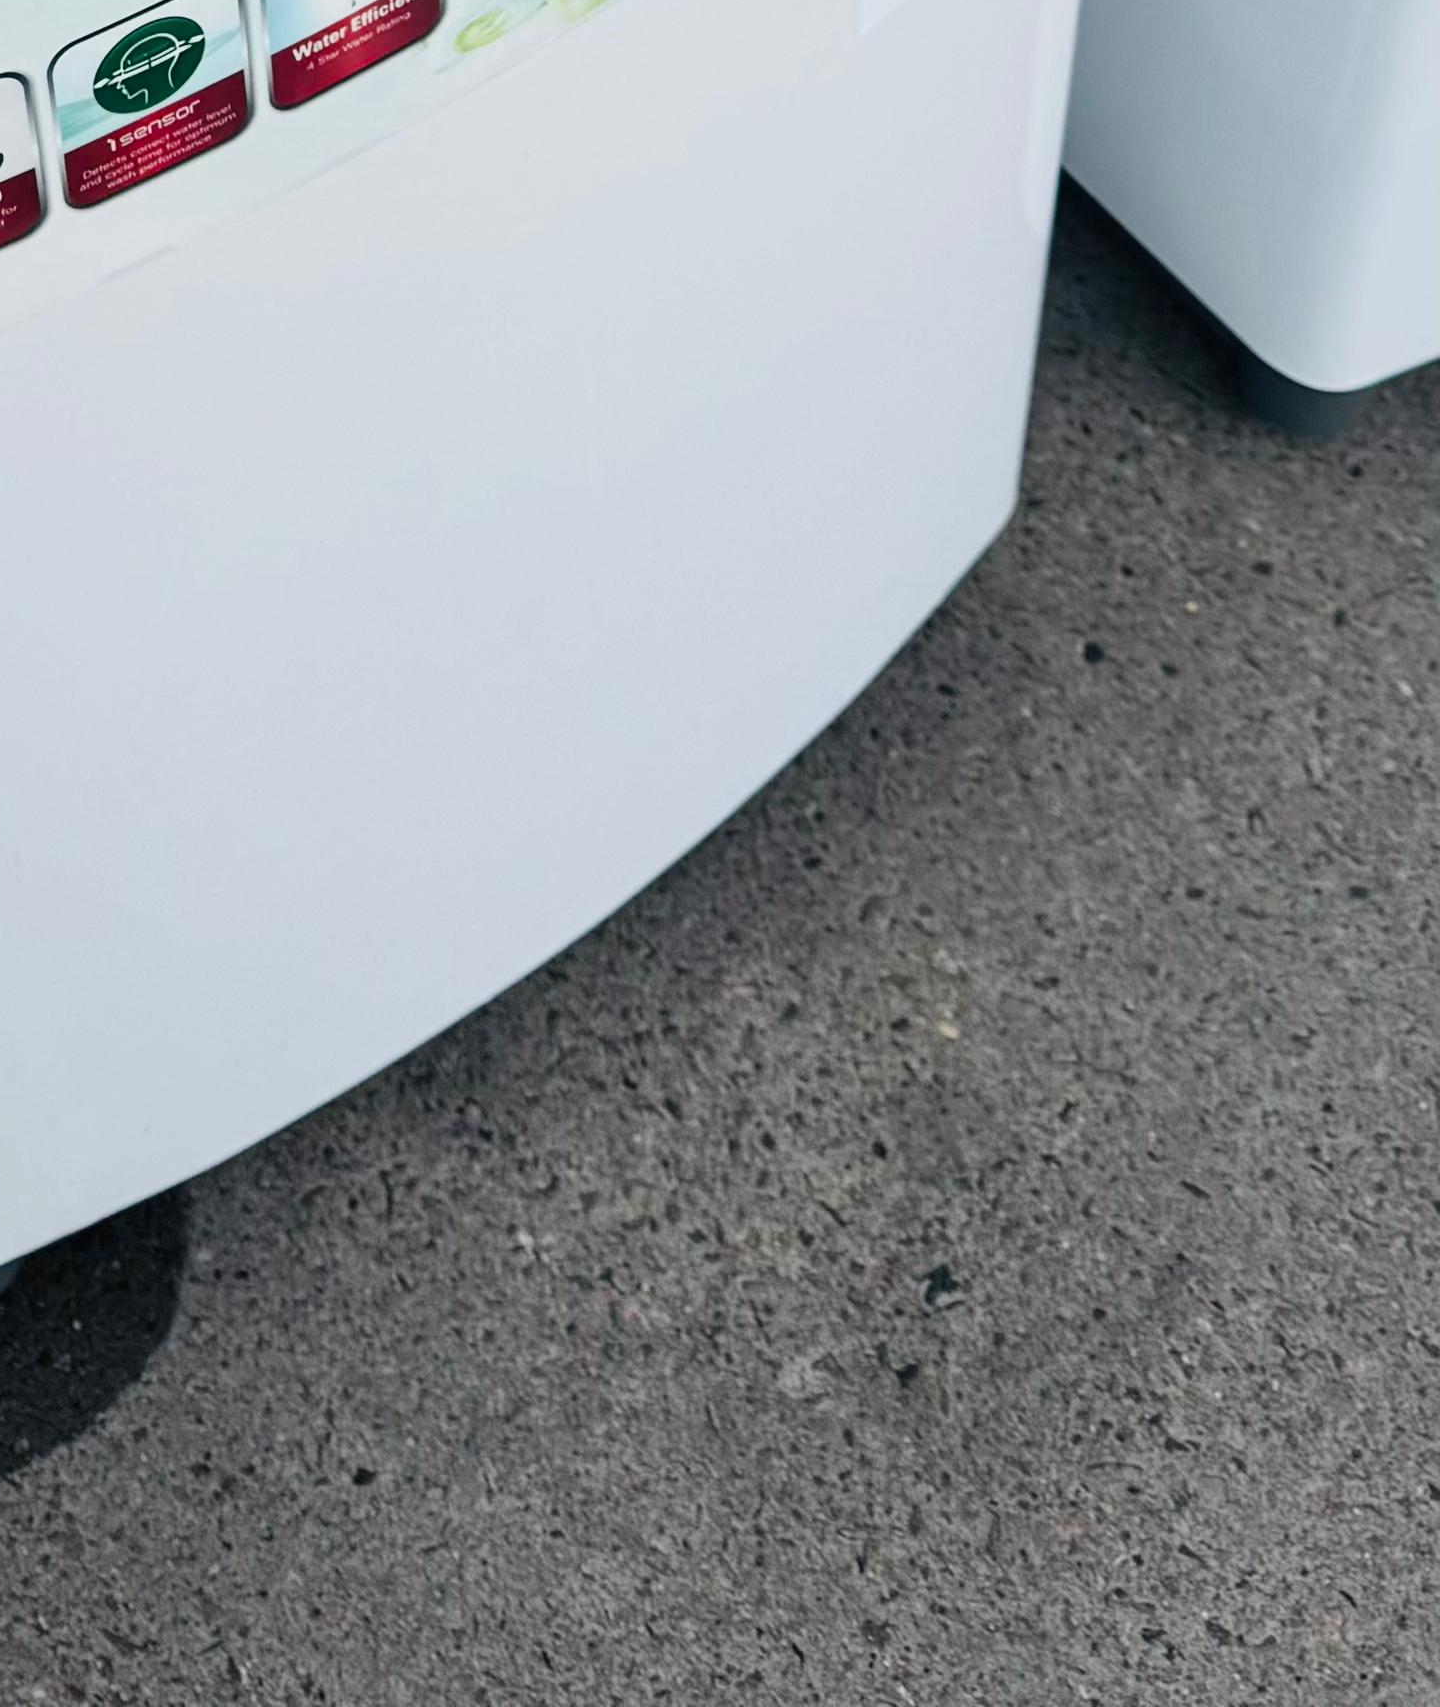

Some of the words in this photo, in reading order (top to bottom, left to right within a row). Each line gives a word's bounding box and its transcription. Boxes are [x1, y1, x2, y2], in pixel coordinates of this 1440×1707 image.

[292, 25, 348, 63] Water
[79, 176, 103, 193] and
[105, 161, 135, 184] cycle
[137, 147, 164, 166] time
[165, 139, 182, 154] for
[184, 111, 238, 144] optimum
[82, 154, 128, 181] Detects
[130, 133, 171, 159] correct
[172, 118, 203, 138] water
[206, 103, 233, 122] level
[106, 171, 137, 190] wash
[139, 134, 213, 177] performance
[0, 204, 19, 218] for
